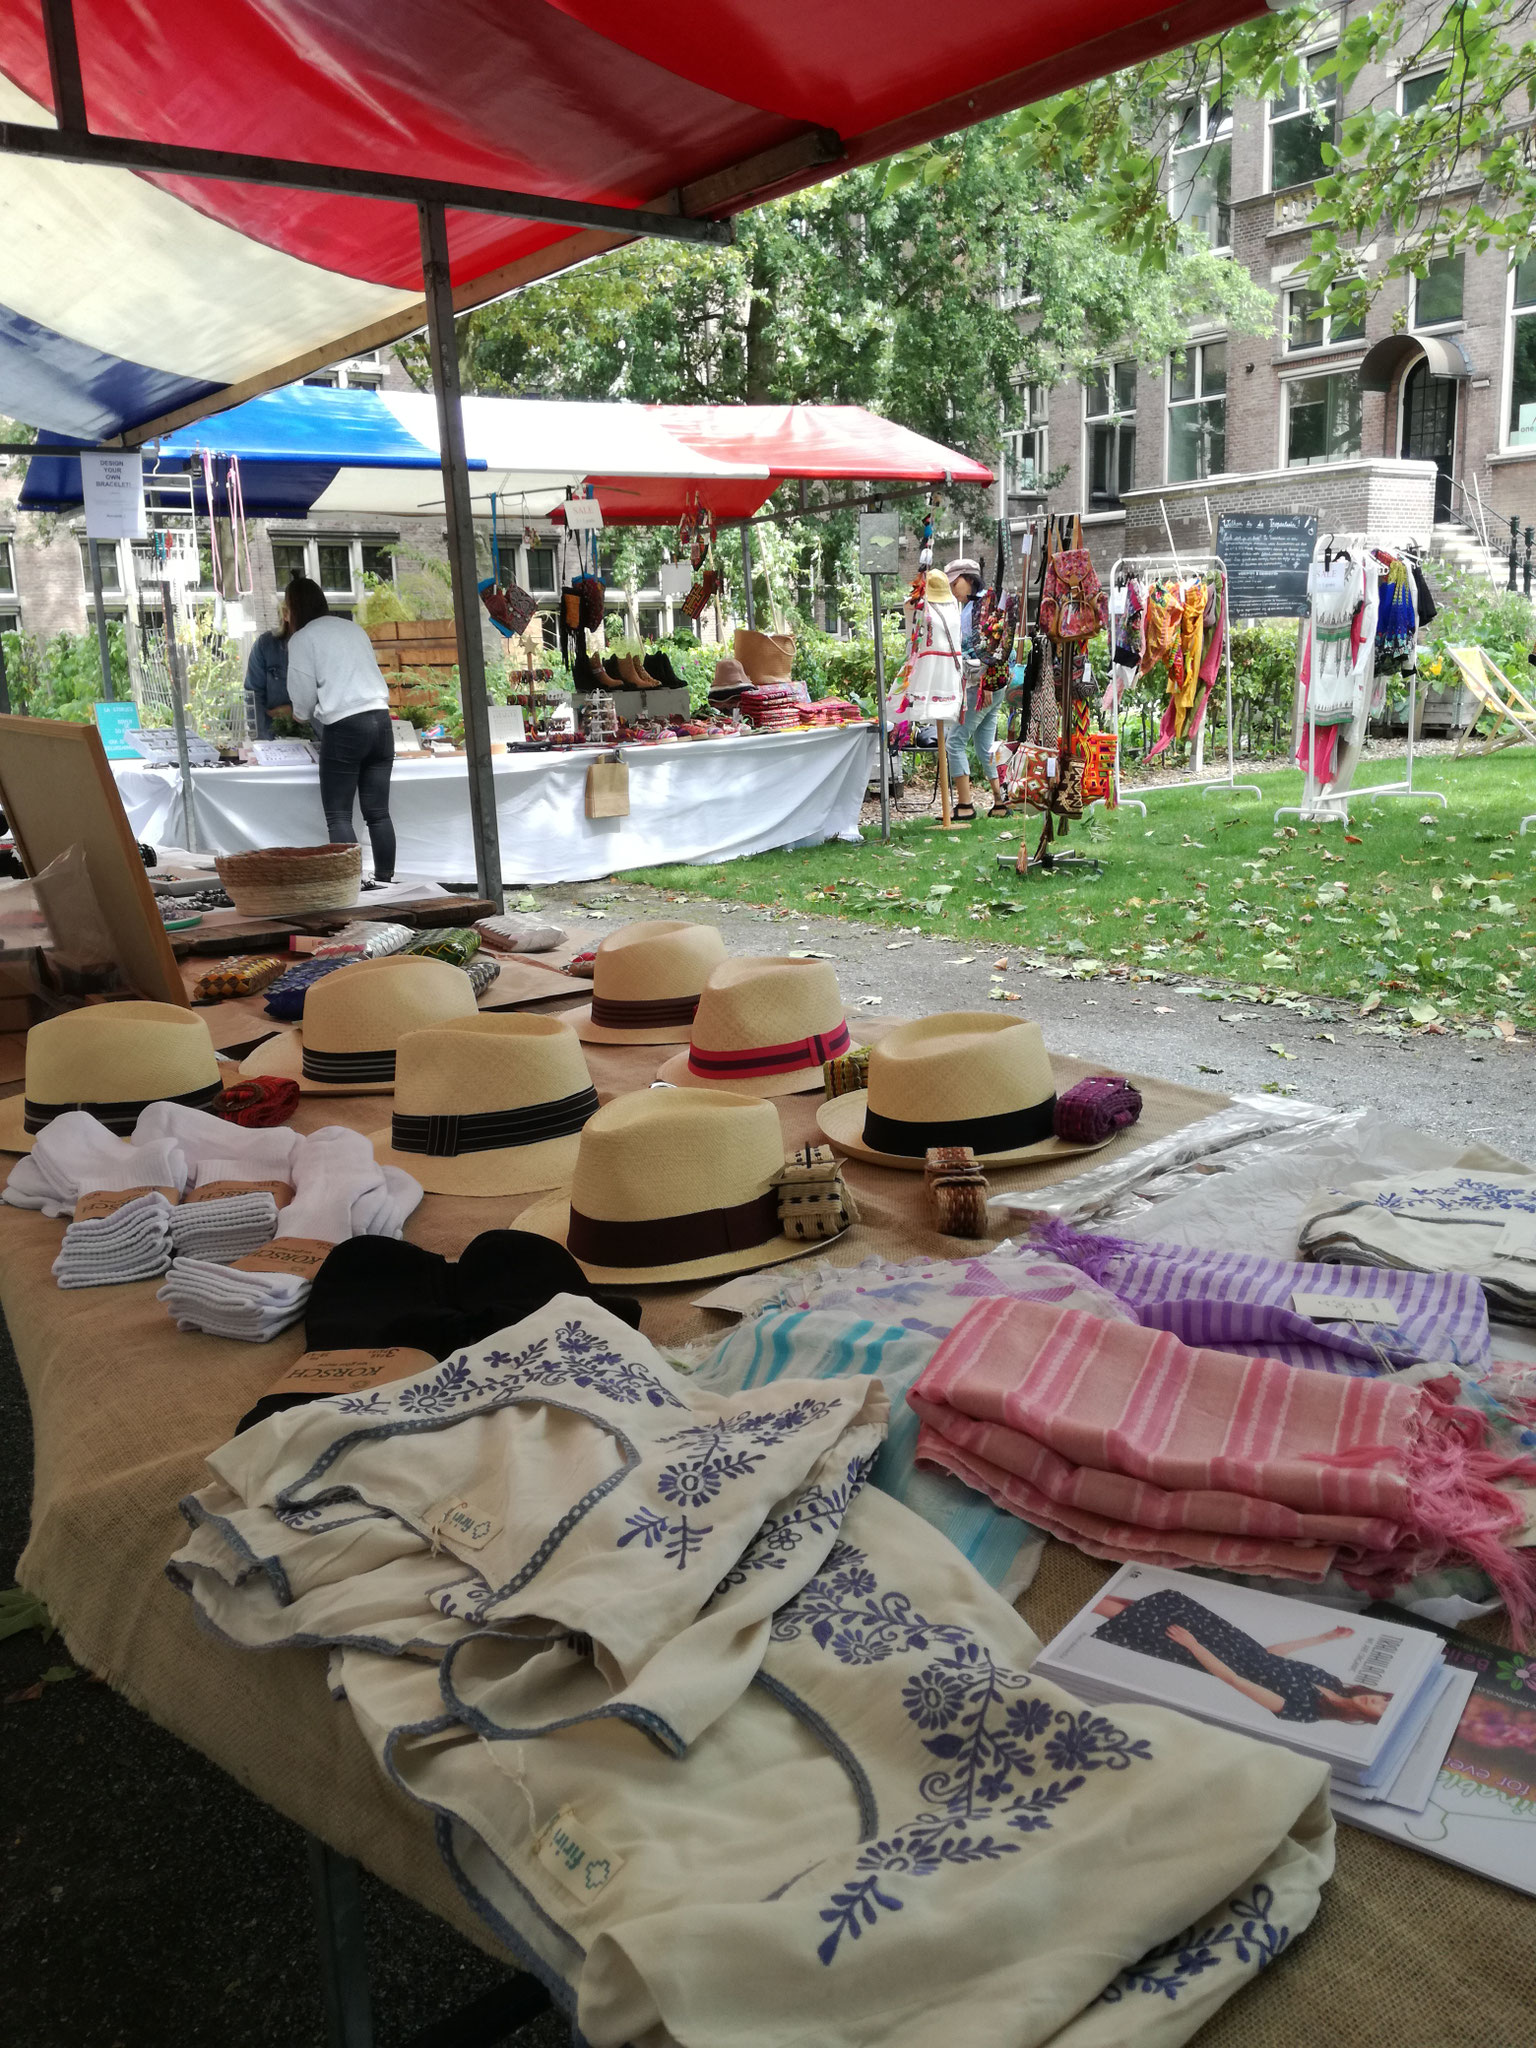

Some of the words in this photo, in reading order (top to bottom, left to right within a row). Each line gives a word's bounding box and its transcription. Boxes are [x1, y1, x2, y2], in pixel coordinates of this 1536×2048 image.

[1317, 570, 1337, 578] SALE
[286, 1365, 385, 1379] KORSCH
[1497, 1776, 1530, 1796] for
